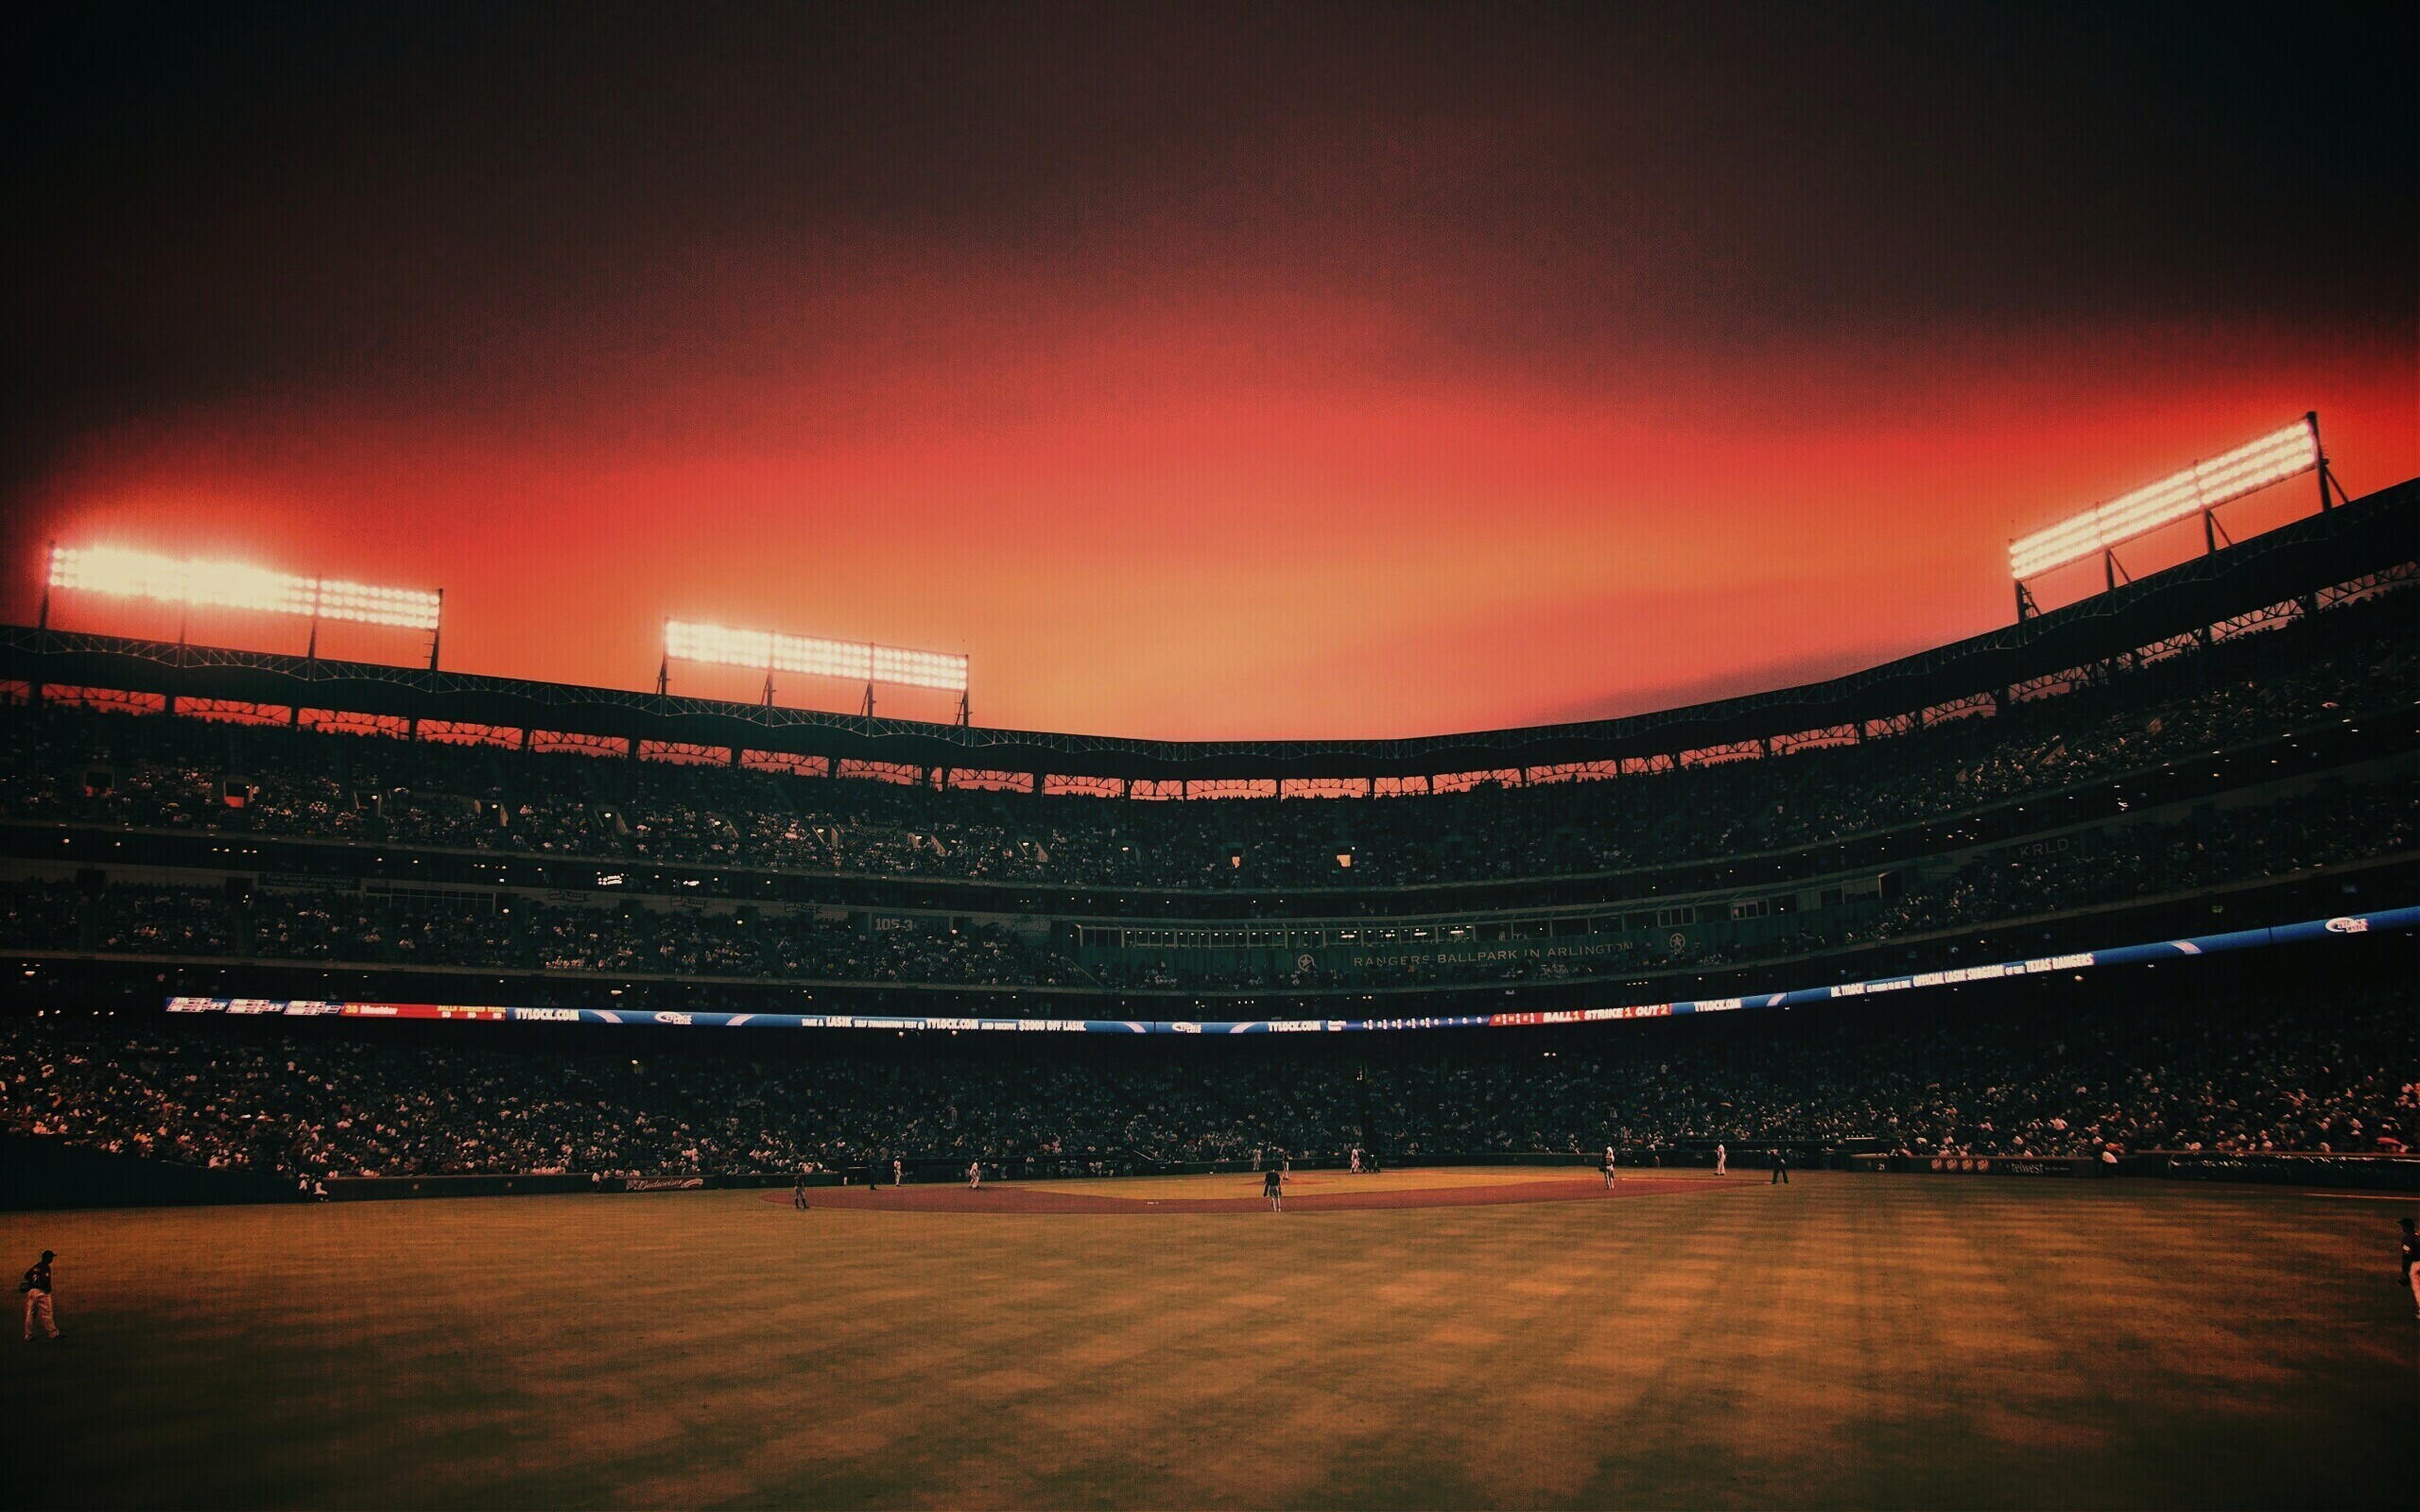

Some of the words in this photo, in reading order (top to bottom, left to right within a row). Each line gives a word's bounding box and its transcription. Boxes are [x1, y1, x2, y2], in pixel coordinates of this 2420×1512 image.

[2019, 838, 2069, 857] KRLD
[1354, 954, 1430, 967] RANGERS
[1437, 950, 1518, 964] BALLPARK
[1524, 949, 1540, 958] IN
[1547, 942, 1634, 957] ARLINGTON
[1913, 972, 1945, 987] OFFICIAL
[1945, 970, 1967, 983] LASIK
[1966, 964, 2005, 981] SURGEON
[2025, 958, 2052, 972] TEXAS
[2051, 953, 2095, 970] RANGERS
[1694, 998, 1741, 1012] TYLOCK.COM
[515, 1007, 580, 1021] TYLOCK.COM
[1543, 1011, 1573, 1022] BALL
[1573, 1011, 1579, 1021] 1
[1584, 1007, 1623, 1021] STRIKE
[1625, 1006, 1632, 1018] 1
[1635, 1005, 1659, 1017] OUT
[1660, 1004, 1668, 1015] 2
[825, 1016, 852, 1027] LASIK
[925, 1018, 979, 1030] TYLOCK.COM
[1018, 1020, 1046, 1031] $2000
[1046, 1020, 1063, 1031] OFF
[1268, 1021, 1322, 1032] TYLOCK.COM
[2012, 1160, 2044, 1174] telwest
[638, 1178, 683, 1190] Budweiser
